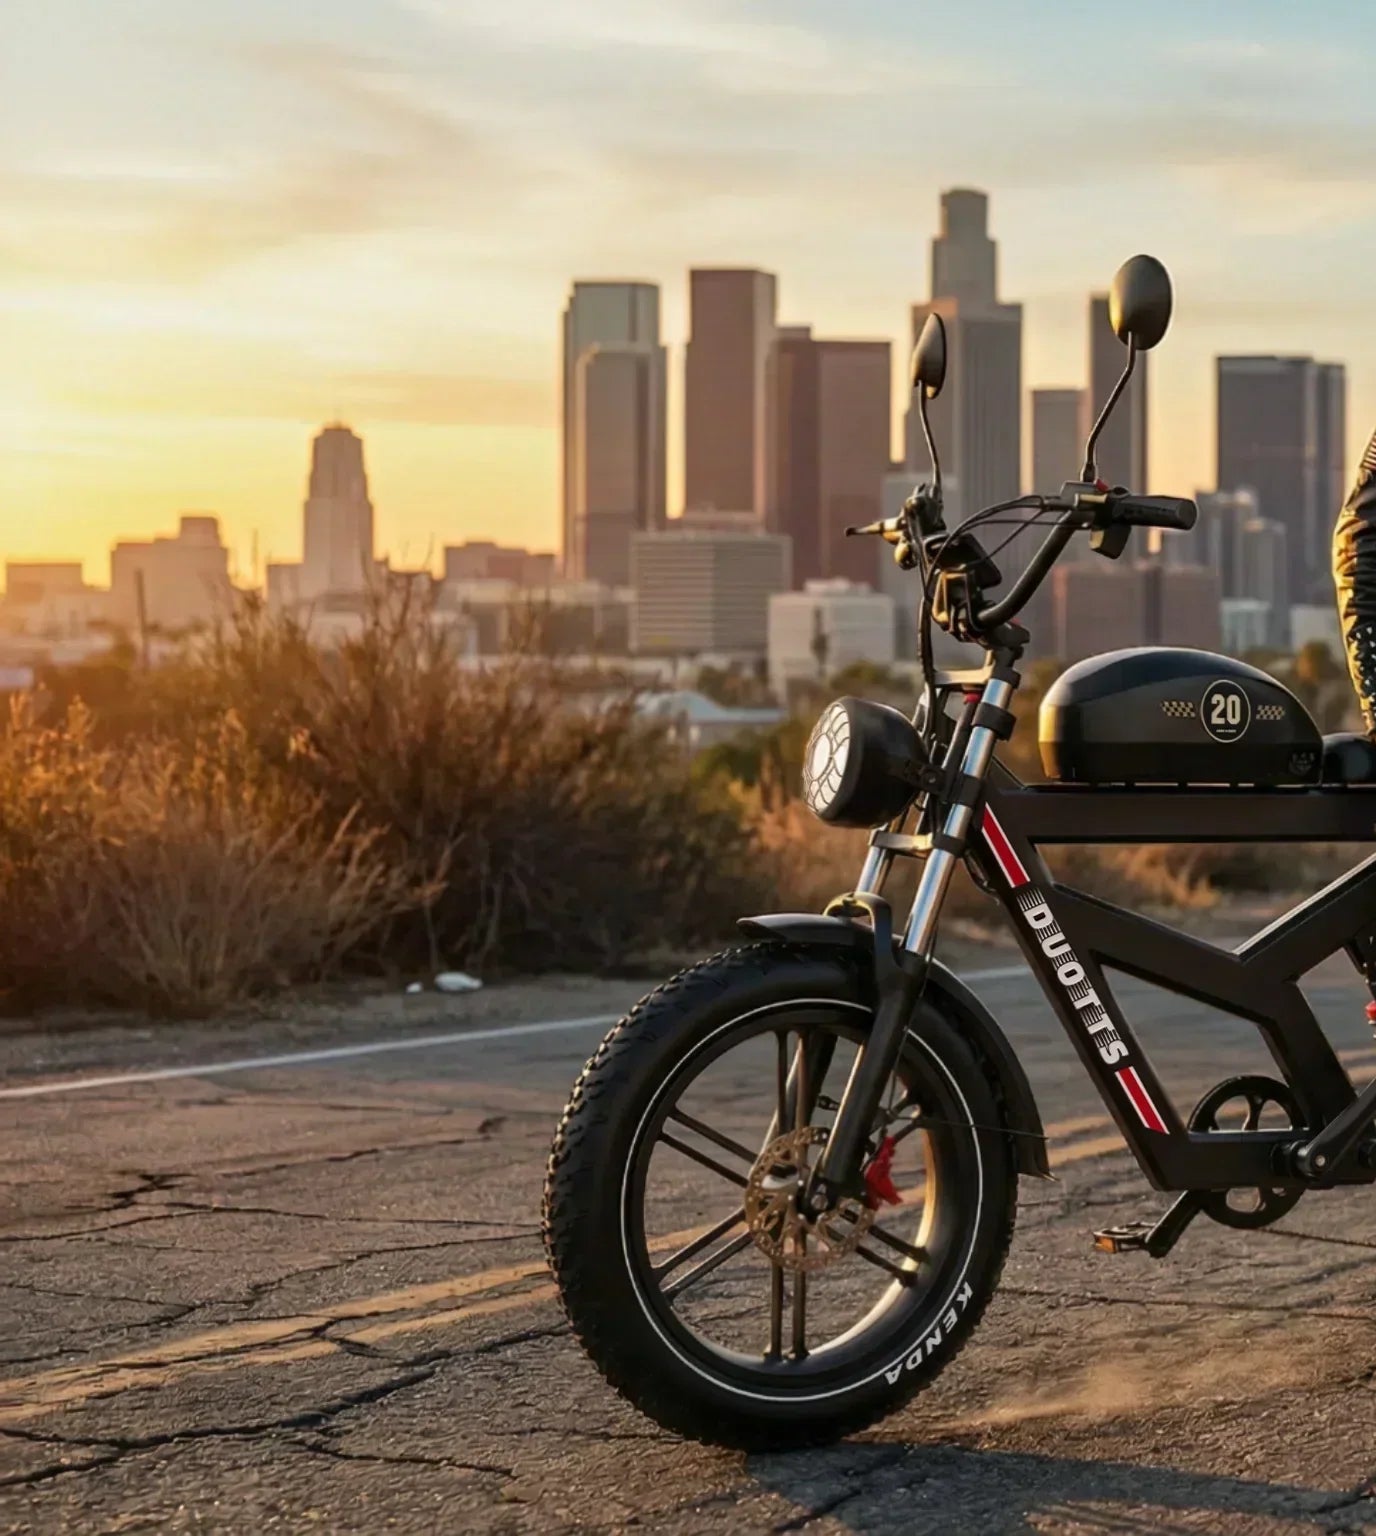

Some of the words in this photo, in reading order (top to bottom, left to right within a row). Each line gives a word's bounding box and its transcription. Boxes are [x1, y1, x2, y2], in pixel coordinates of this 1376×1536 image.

[1210, 693, 1241, 725] 20
[1018, 888, 1129, 1065] DUOTTS
[884, 1281, 973, 1385] KENDA
